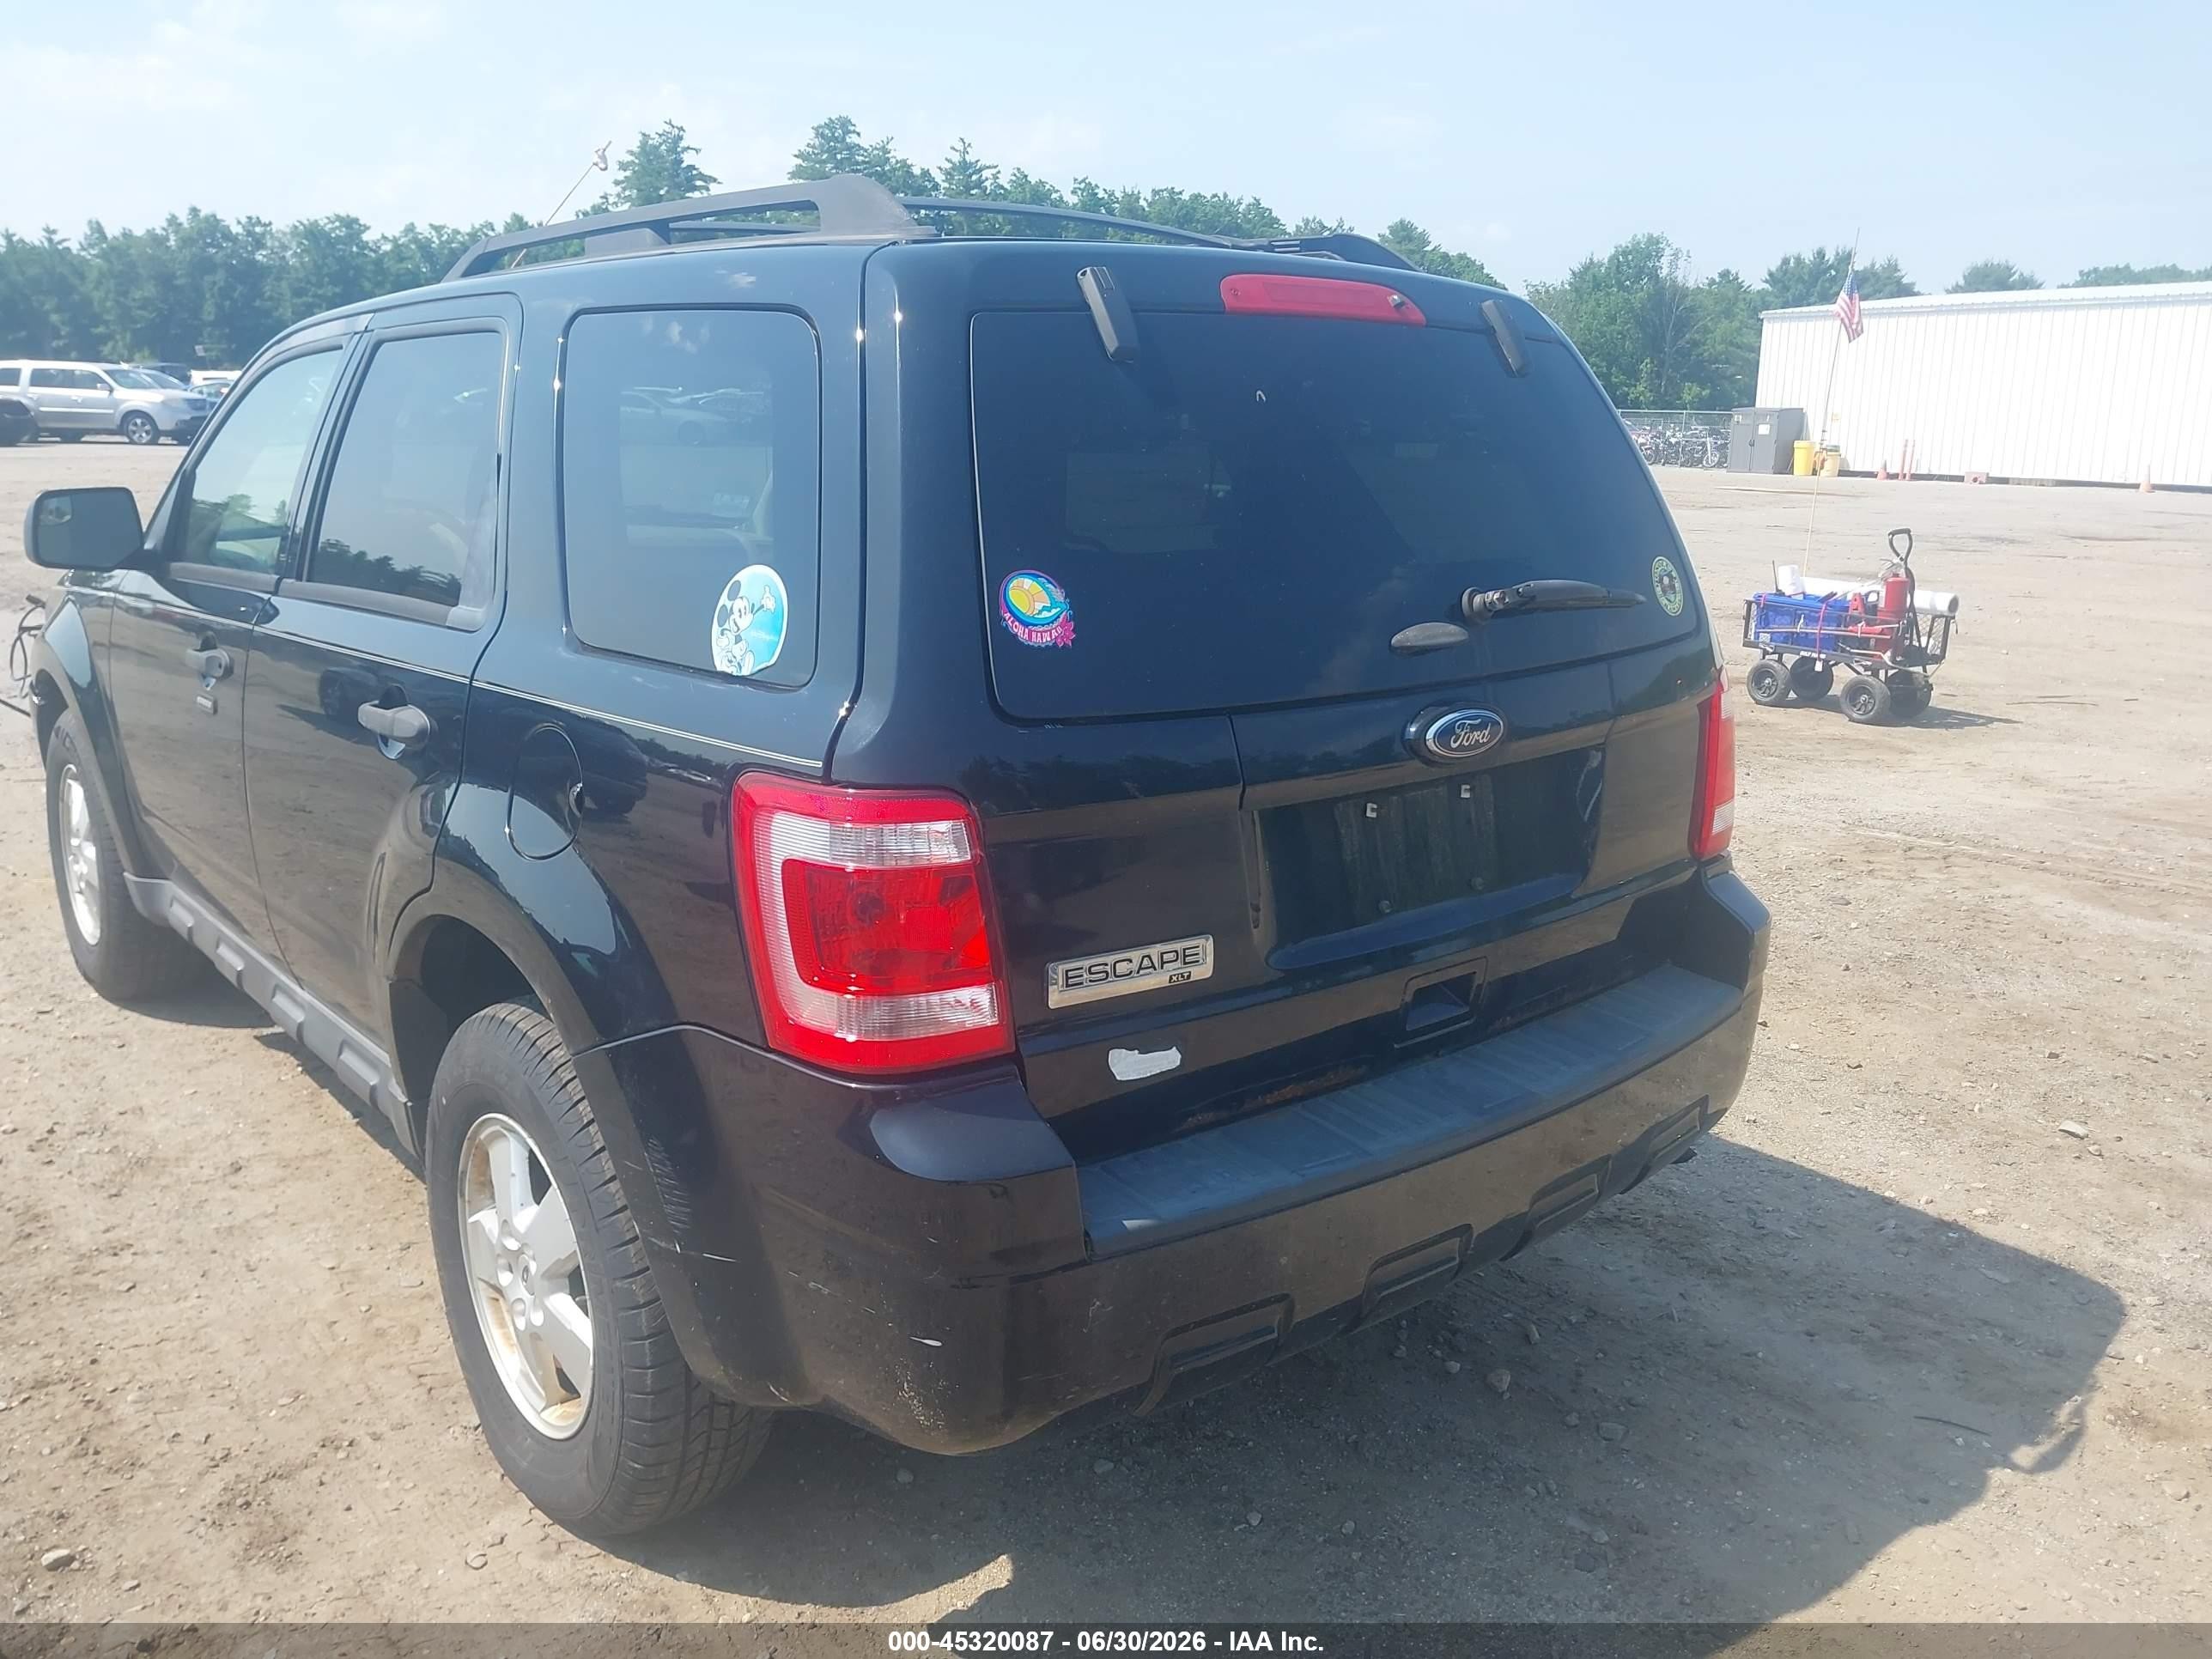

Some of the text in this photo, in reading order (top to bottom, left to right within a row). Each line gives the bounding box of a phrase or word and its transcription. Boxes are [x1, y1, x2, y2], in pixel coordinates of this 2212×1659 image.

[1003, 611, 1029, 641] ALOHA
[1449, 718, 1492, 749] Ford
[1064, 945, 1201, 989] ESCAPE
[1170, 972, 1191, 982] XLT
